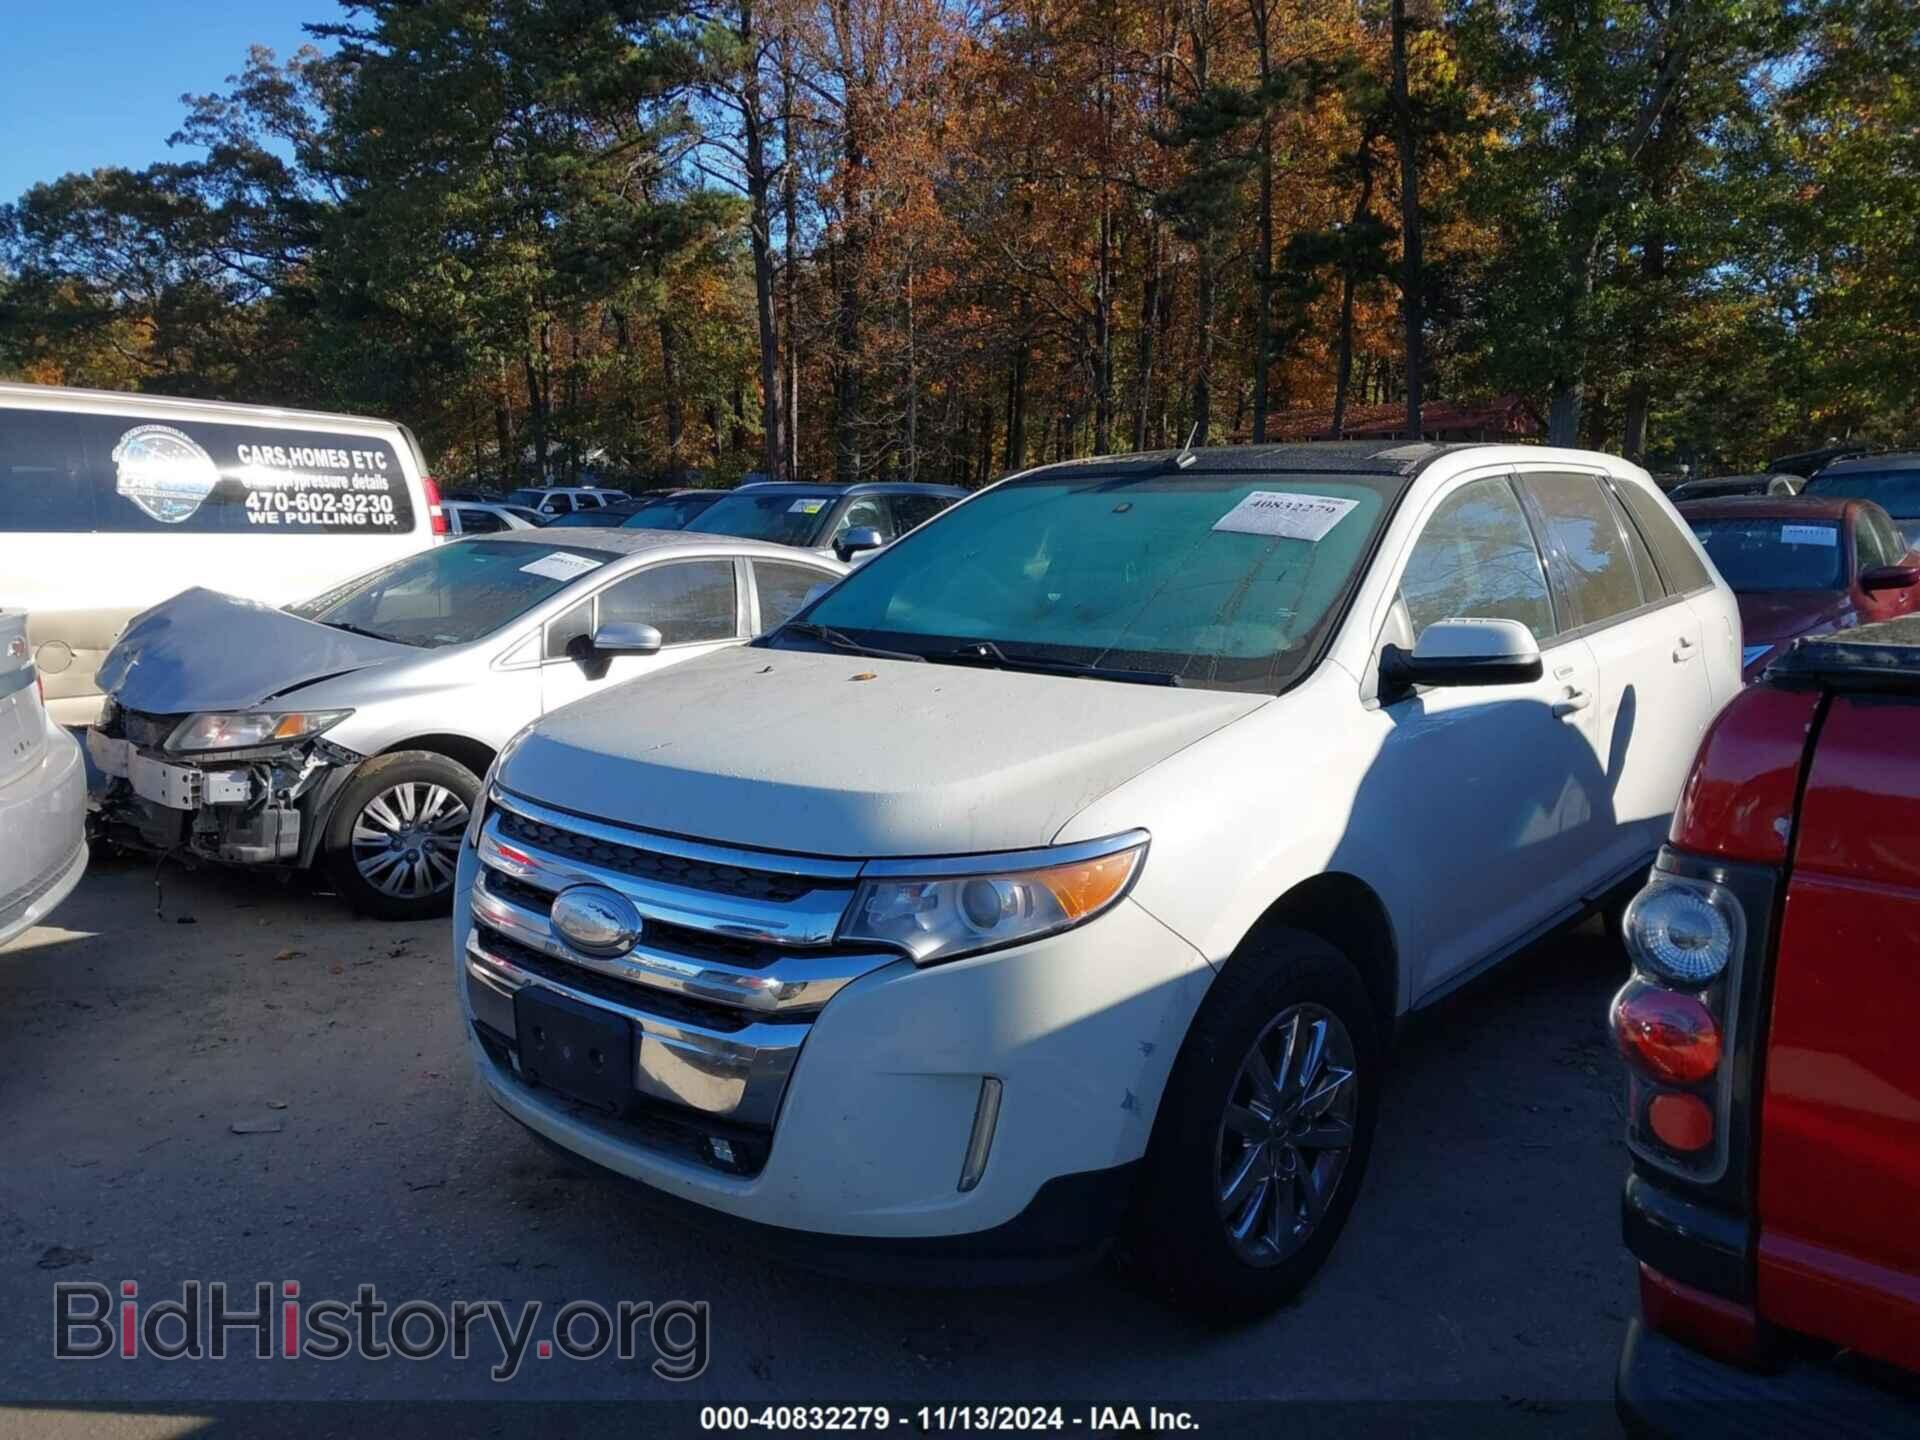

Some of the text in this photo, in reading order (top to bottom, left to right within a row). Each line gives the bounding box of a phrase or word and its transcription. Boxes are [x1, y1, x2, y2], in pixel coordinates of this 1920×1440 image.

[237, 444, 388, 470] CARS,HOMES ETC
[245, 491, 393, 513] 470-602-9230
[1249, 498, 1337, 514] 40832279
[247, 512, 398, 525] WE PULLING UP.
